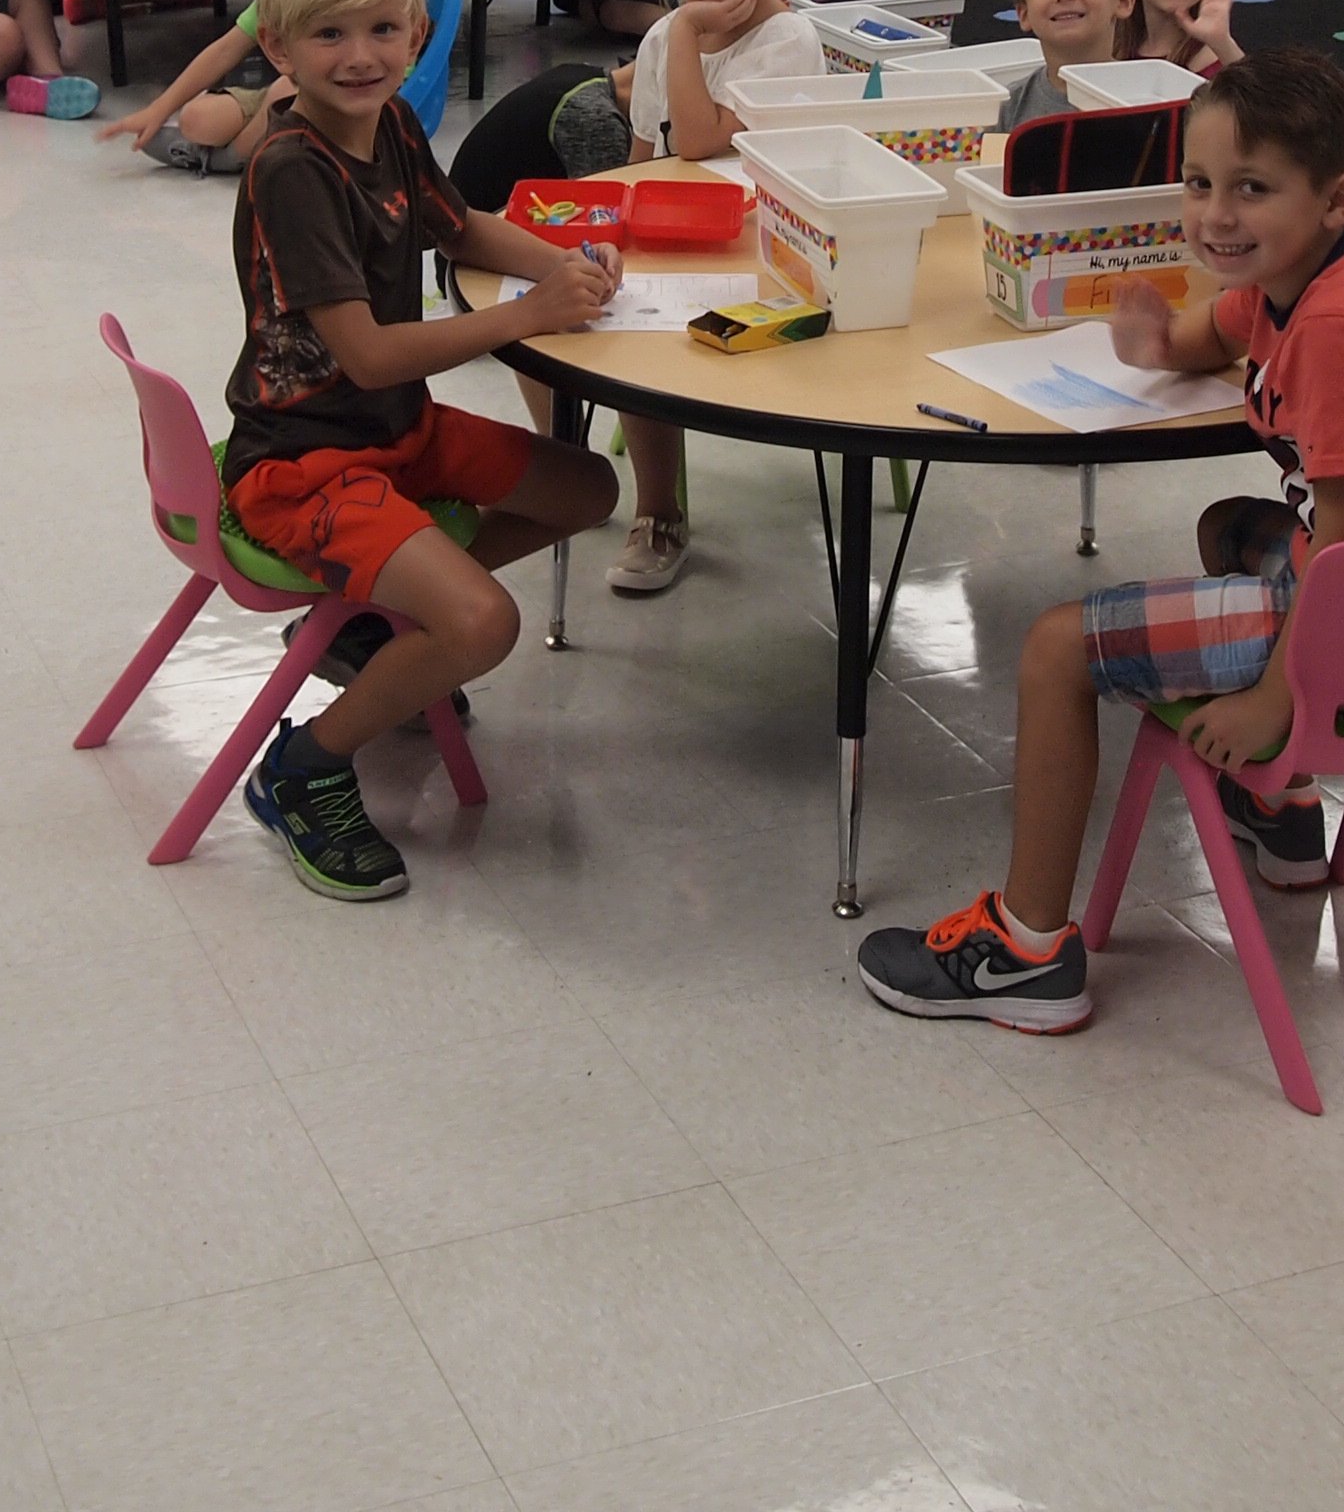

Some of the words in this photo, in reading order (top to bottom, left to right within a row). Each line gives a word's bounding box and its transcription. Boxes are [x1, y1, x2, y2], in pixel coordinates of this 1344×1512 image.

[1090, 256, 1105, 269] Hi,
[1108, 256, 1130, 272] my
[1133, 252, 1167, 266] name
[996, 272, 1006, 301] 15
